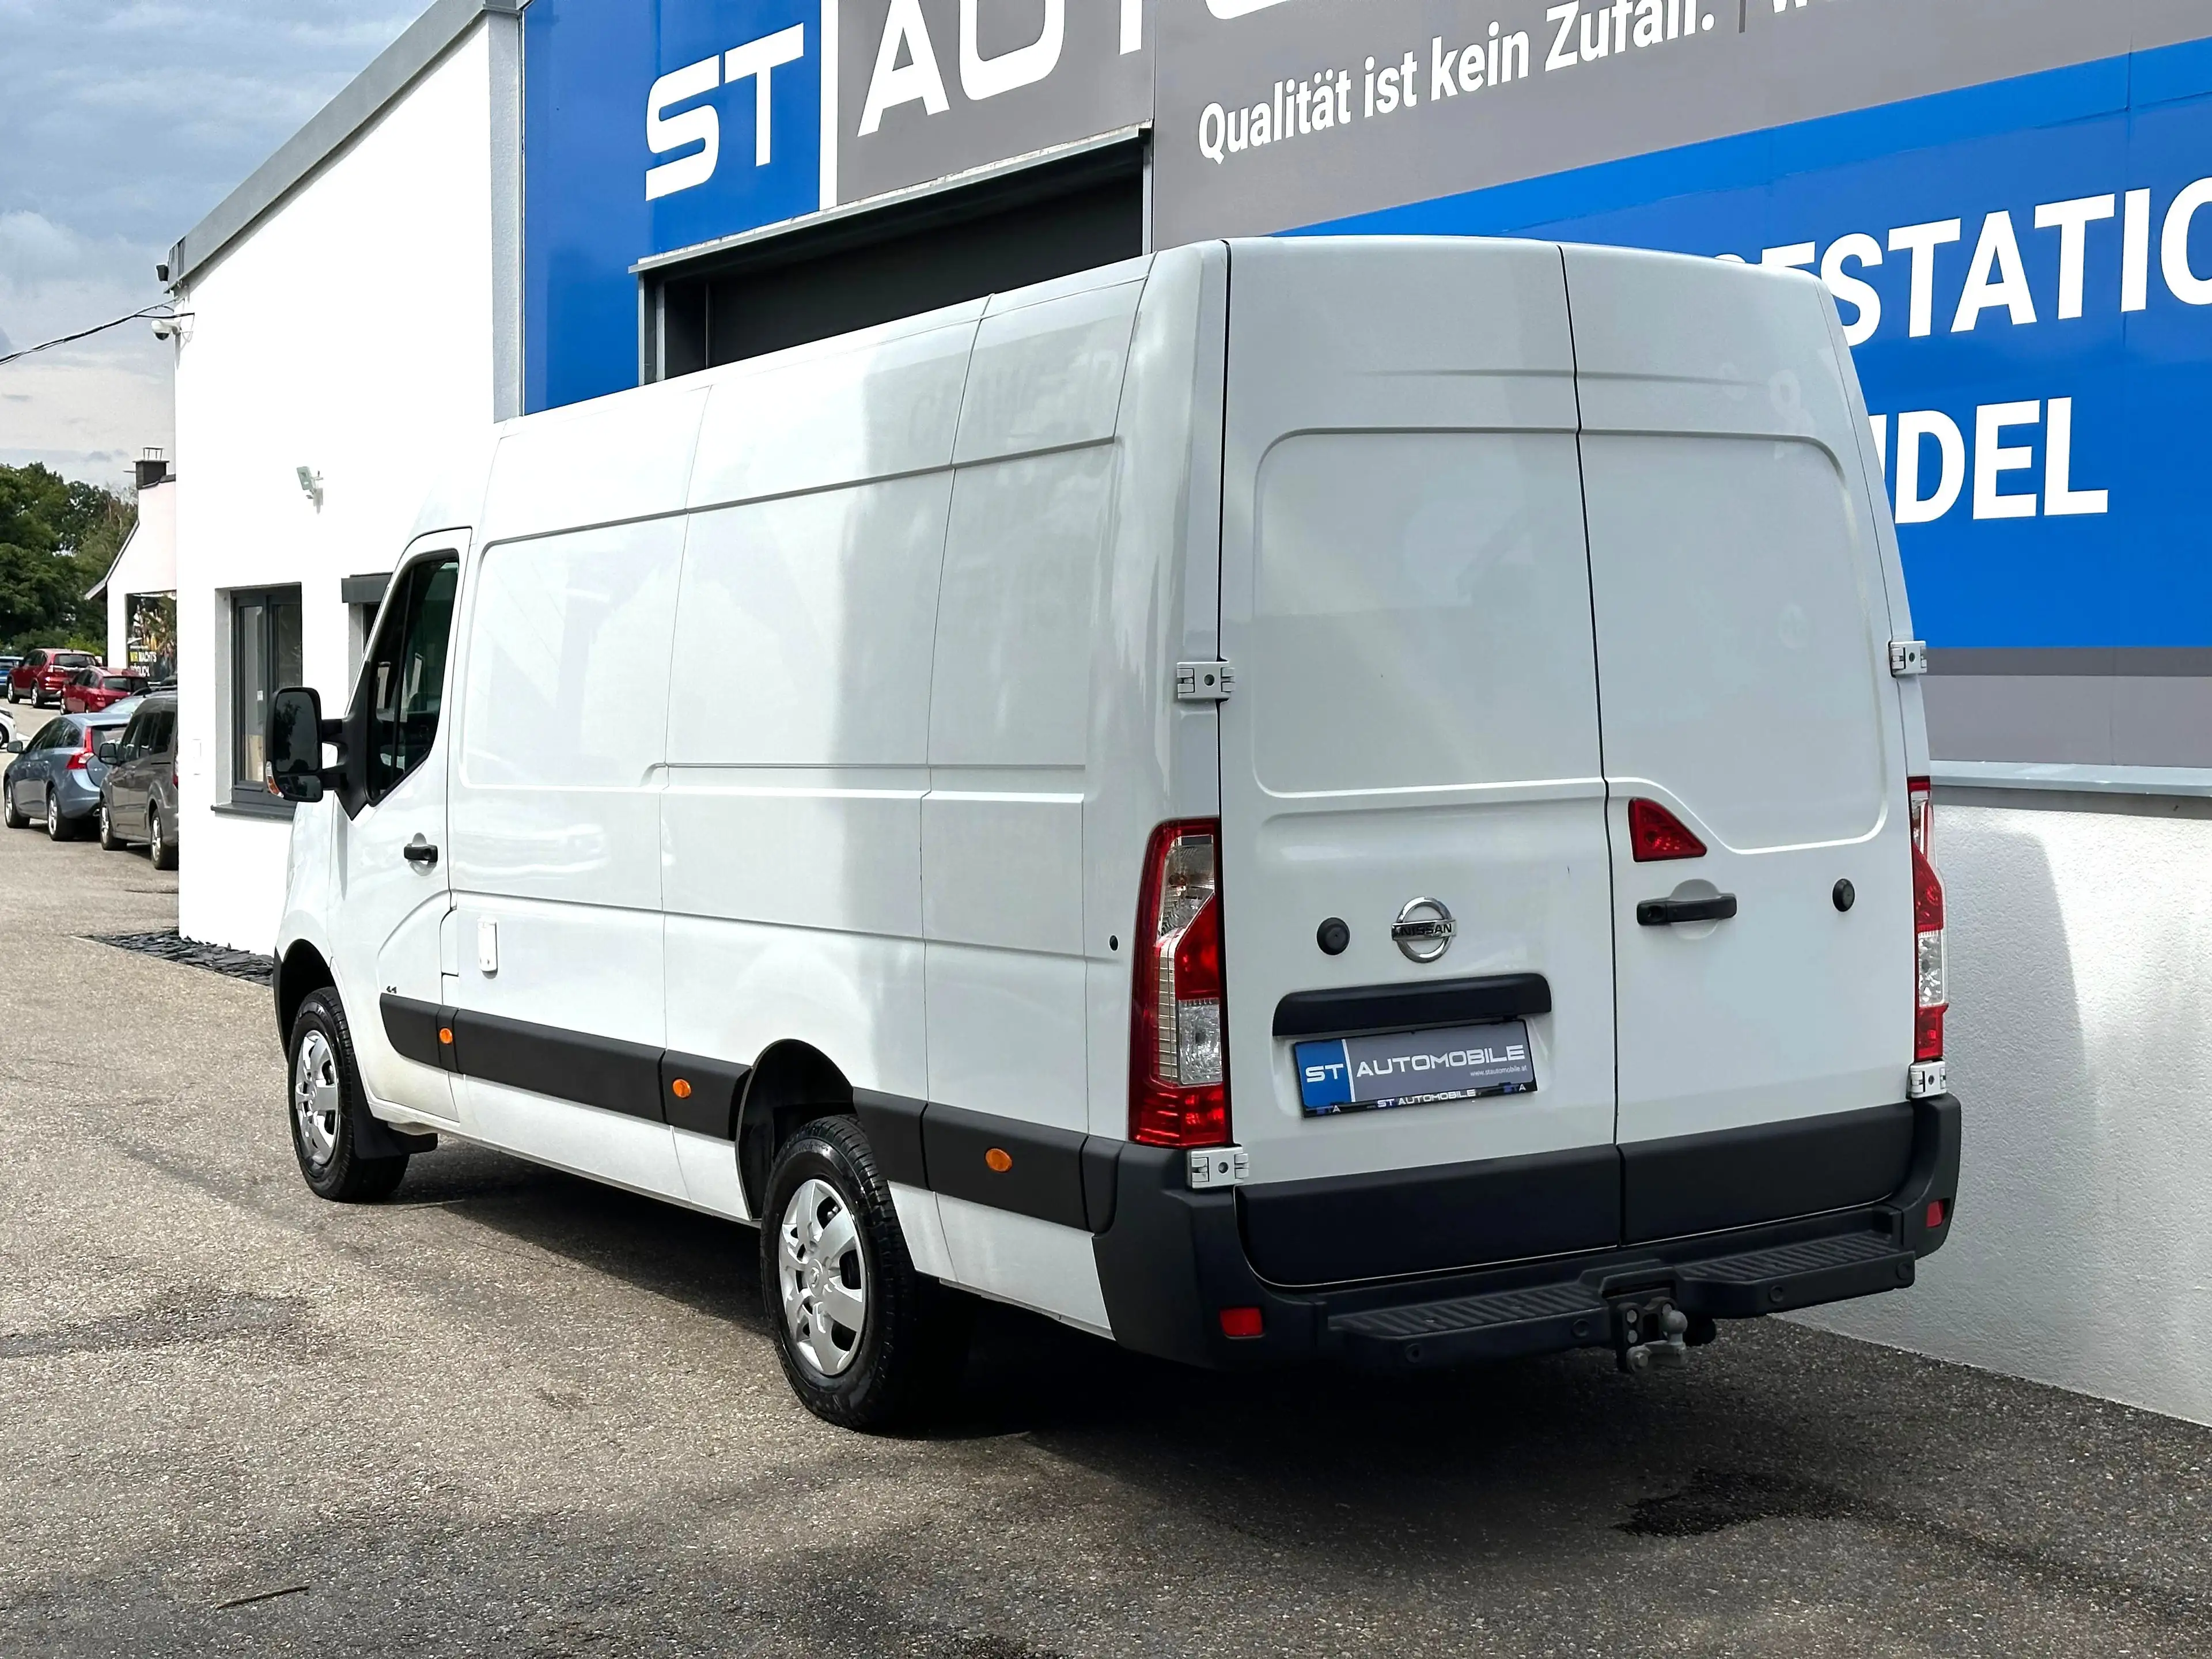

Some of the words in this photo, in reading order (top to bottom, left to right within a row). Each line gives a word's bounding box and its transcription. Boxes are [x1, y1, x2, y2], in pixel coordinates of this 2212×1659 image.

[646, 22, 804, 201] ST
[1198, 68, 1351, 165] Qualität
[1364, 55, 1418, 118] ist
[1430, 21, 1529, 101] kein
[1714, 177, 2212, 346] STATIO
[1867, 397, 2108, 523] DEL
[1401, 923, 1452, 936] NISSAN
[1305, 1063, 1344, 1083] ST
[1357, 1044, 1525, 1078] AUTOMOBILE
[1377, 1098, 1395, 1108] ST
[1398, 1089, 1476, 1106] AUTOMOBILE
